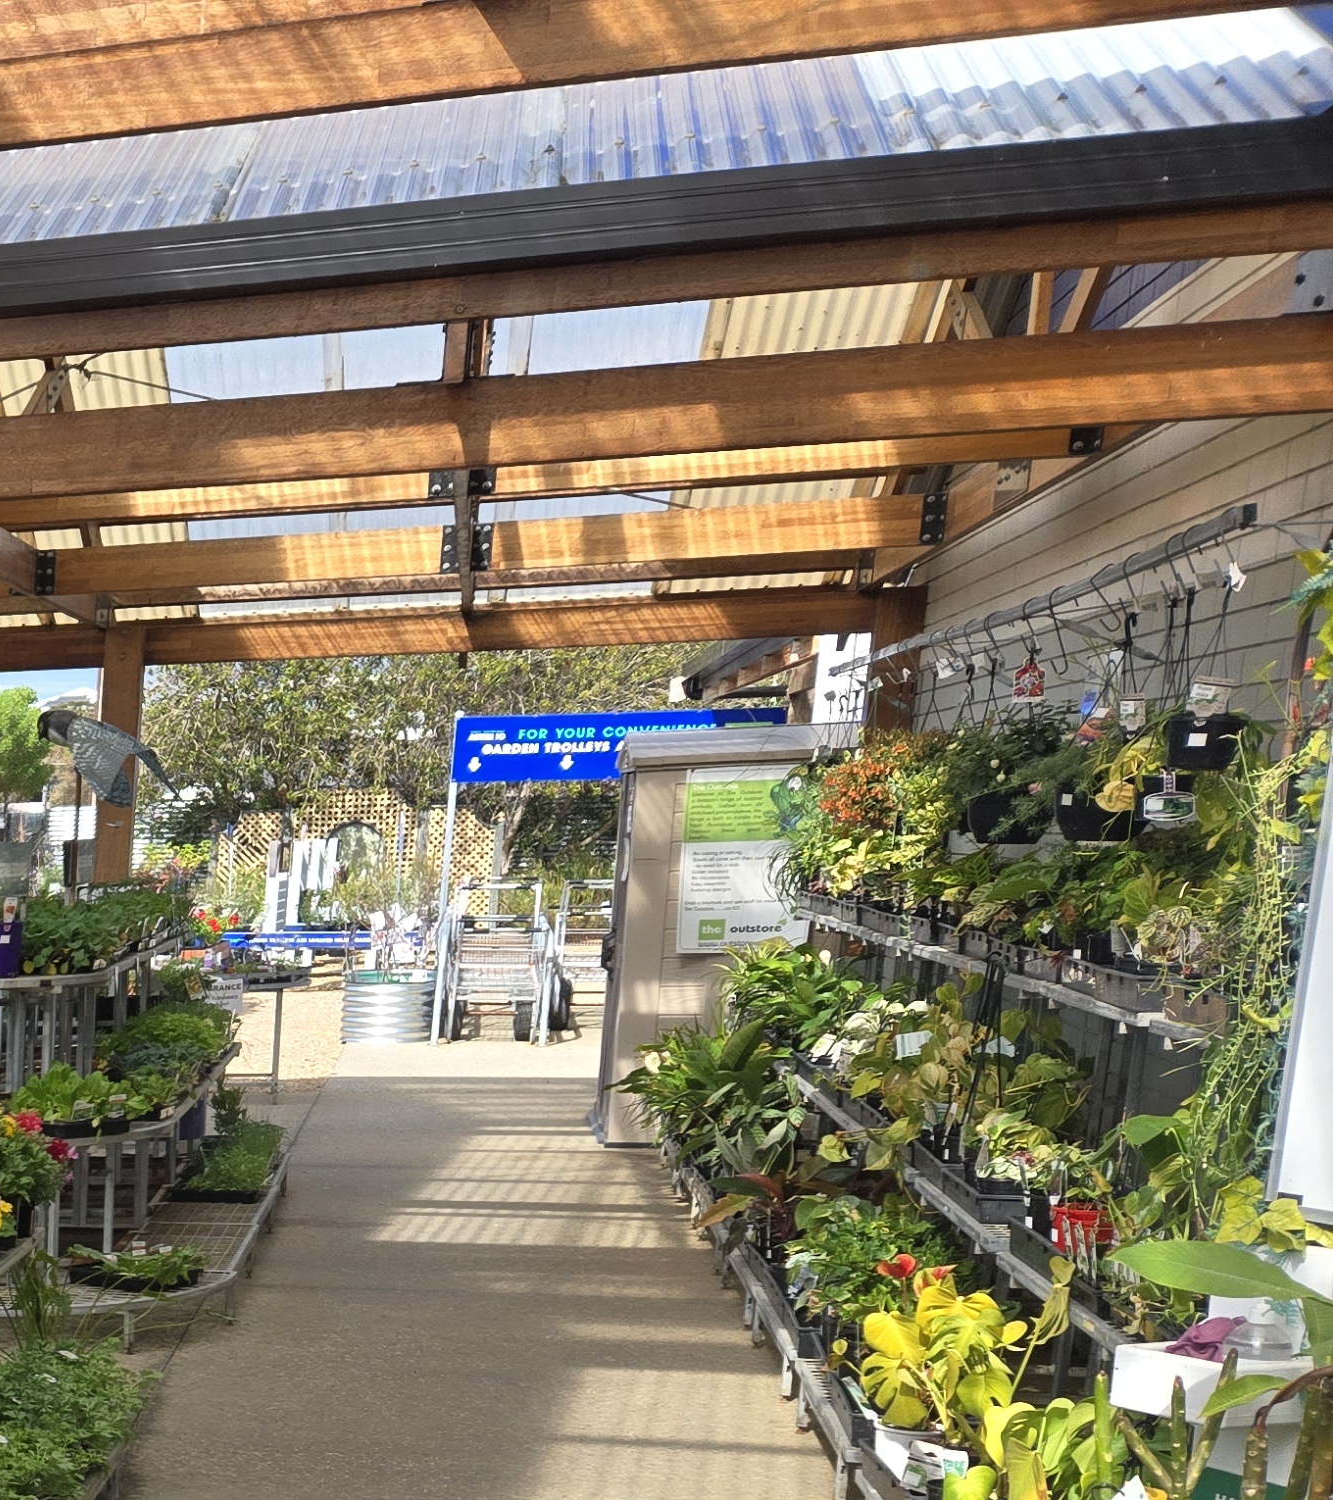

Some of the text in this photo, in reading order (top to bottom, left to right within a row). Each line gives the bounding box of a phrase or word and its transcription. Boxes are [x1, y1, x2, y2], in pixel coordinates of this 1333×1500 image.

[518, 729, 548, 739] FOR
[556, 727, 596, 738] YOUR
[482, 743, 539, 755] GARDEN
[544, 740, 610, 753] TROLLEYS
[702, 924, 783, 934] the outstore
